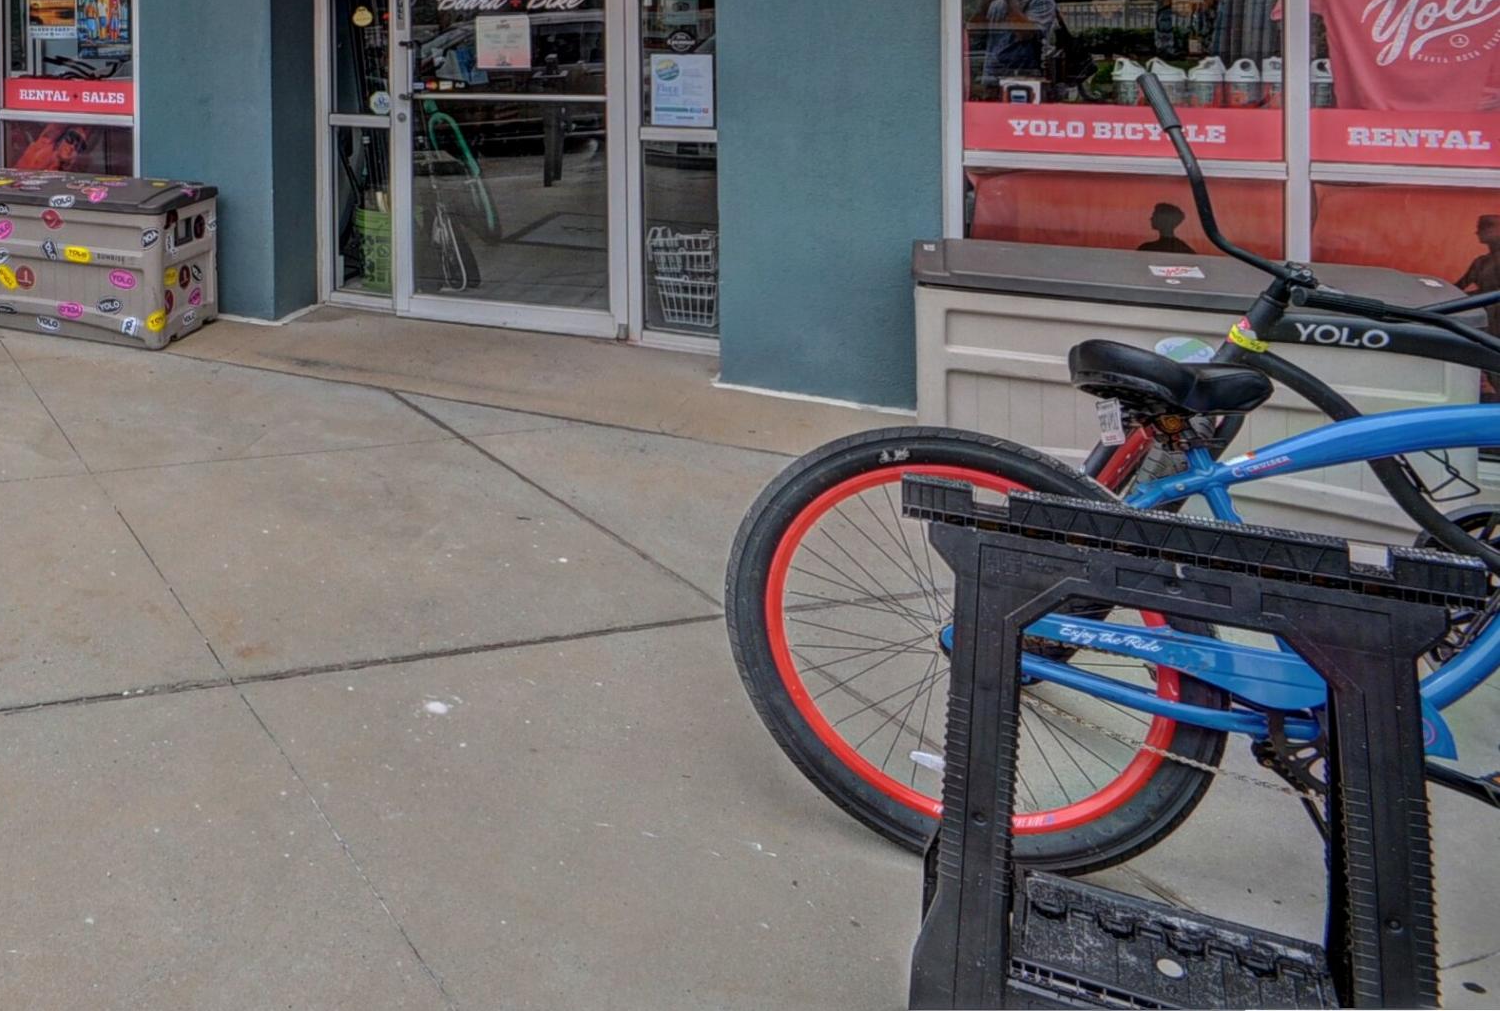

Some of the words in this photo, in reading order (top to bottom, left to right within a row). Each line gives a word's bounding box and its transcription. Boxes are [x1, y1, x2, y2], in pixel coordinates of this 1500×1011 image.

[19, 89, 70, 102] RENTAL
[81, 91, 125, 104] SALES
[1008, 119, 1085, 138] YOLO
[1092, 121, 1226, 143] BICYLE
[1347, 126, 1491, 150] RENTAL
[51, 196, 72, 207] YOLO
[112, 274, 133, 284] YOLO
[99, 301, 120, 310] YOLO
[37, 316, 59, 328] YOLO
[1295, 322, 1390, 349] YOLO
[1060, 623, 1097, 645] Enjoy
[1122, 634, 1163, 652] Ride
